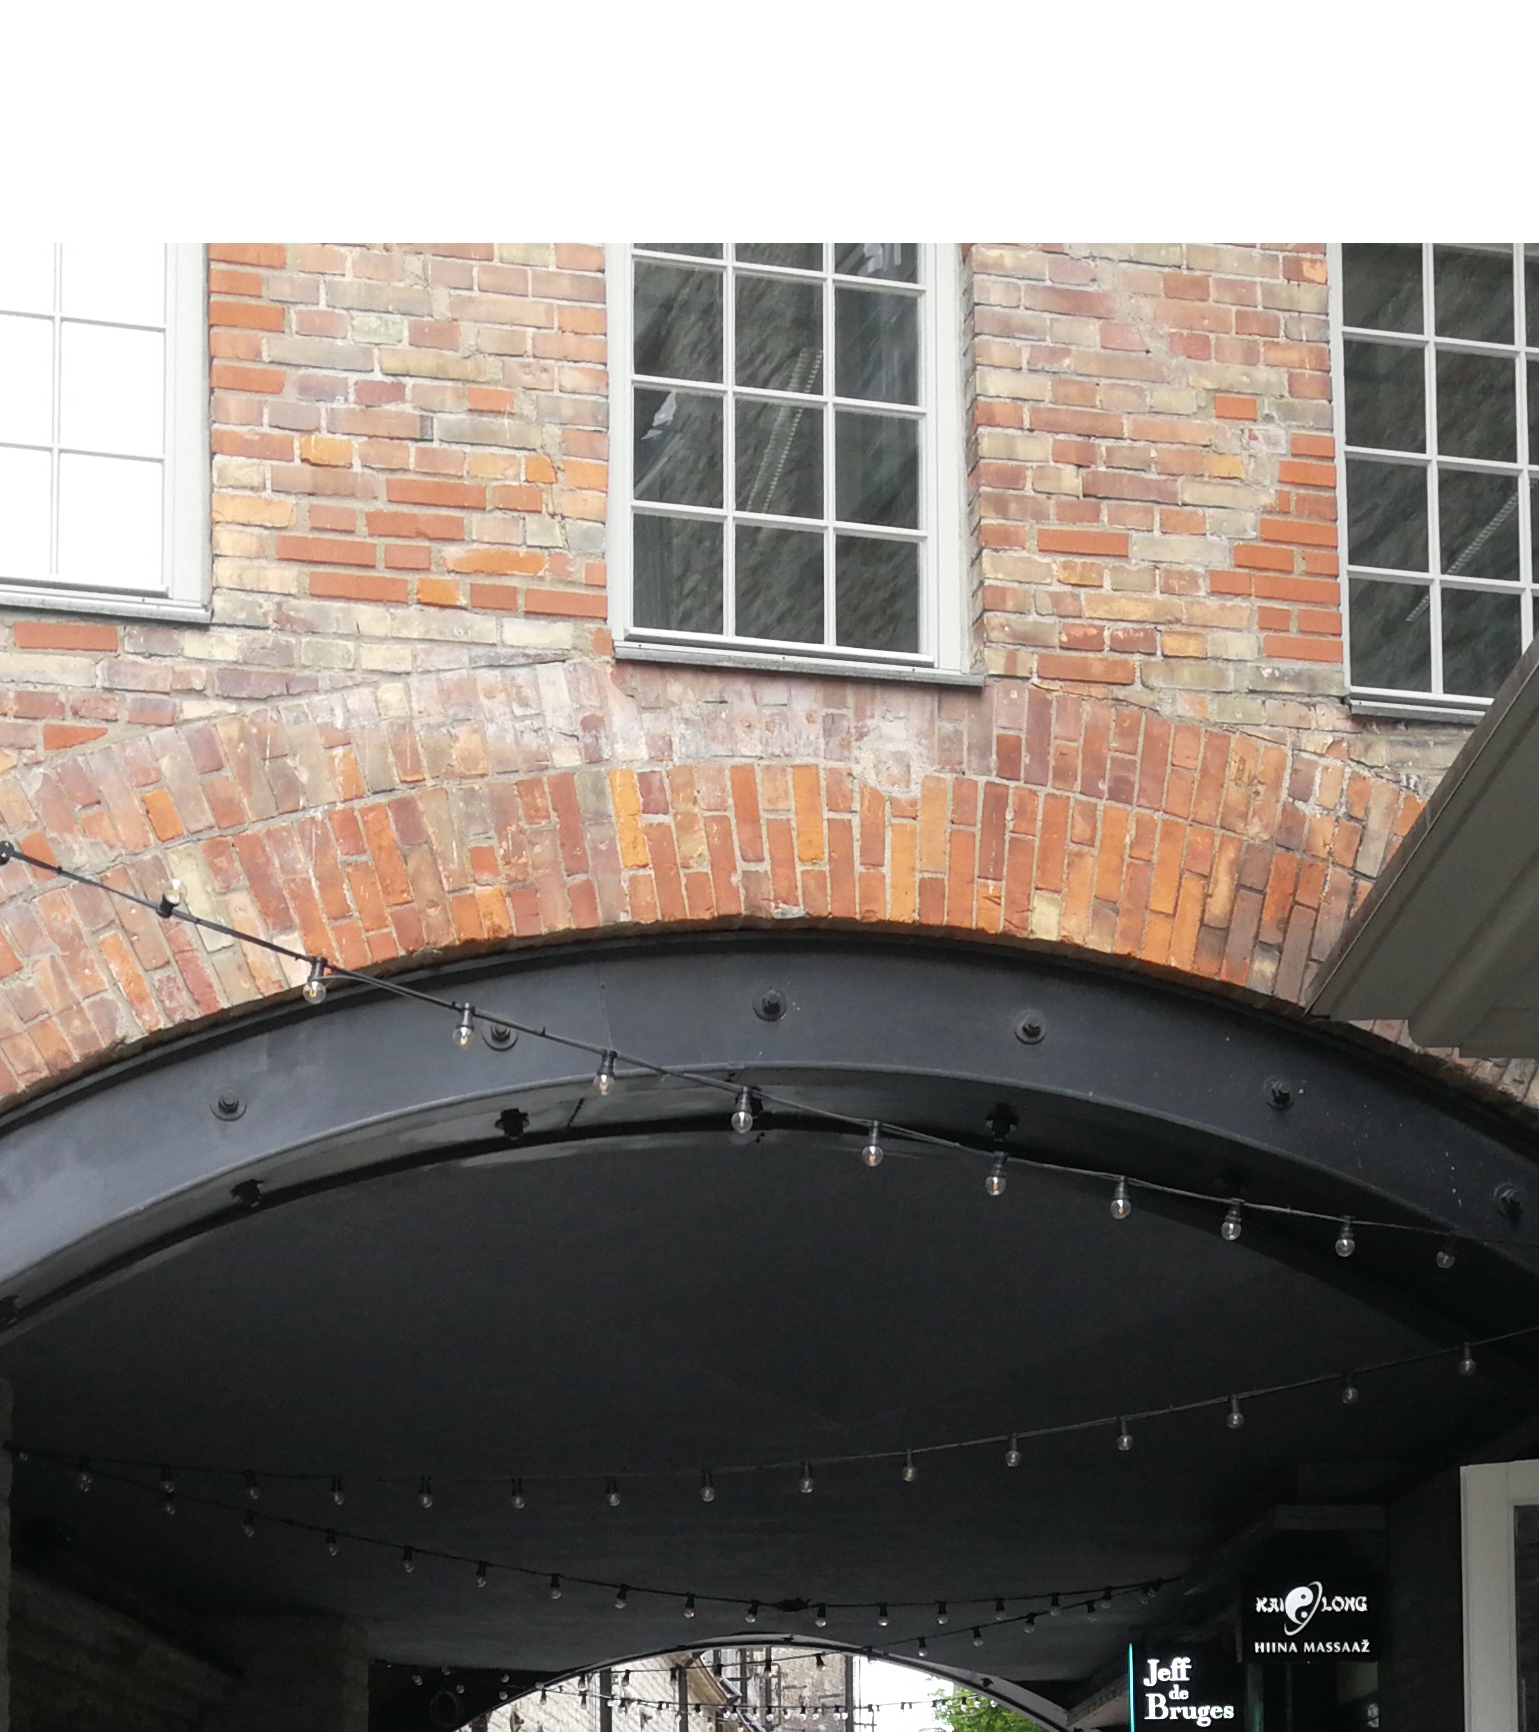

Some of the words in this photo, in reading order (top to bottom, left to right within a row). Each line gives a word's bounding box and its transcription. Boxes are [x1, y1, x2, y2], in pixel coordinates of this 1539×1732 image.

[1255, 1596, 1285, 1613] KAI
[1320, 1595, 1369, 1613] LONG
[1254, 1641, 1298, 1654] HIINA
[1303, 1638, 1370, 1654] MASSAAŽ
[1143, 1656, 1192, 1687] Jeff
[1169, 1684, 1189, 1701] de
[1144, 1693, 1235, 1728] Bruges
